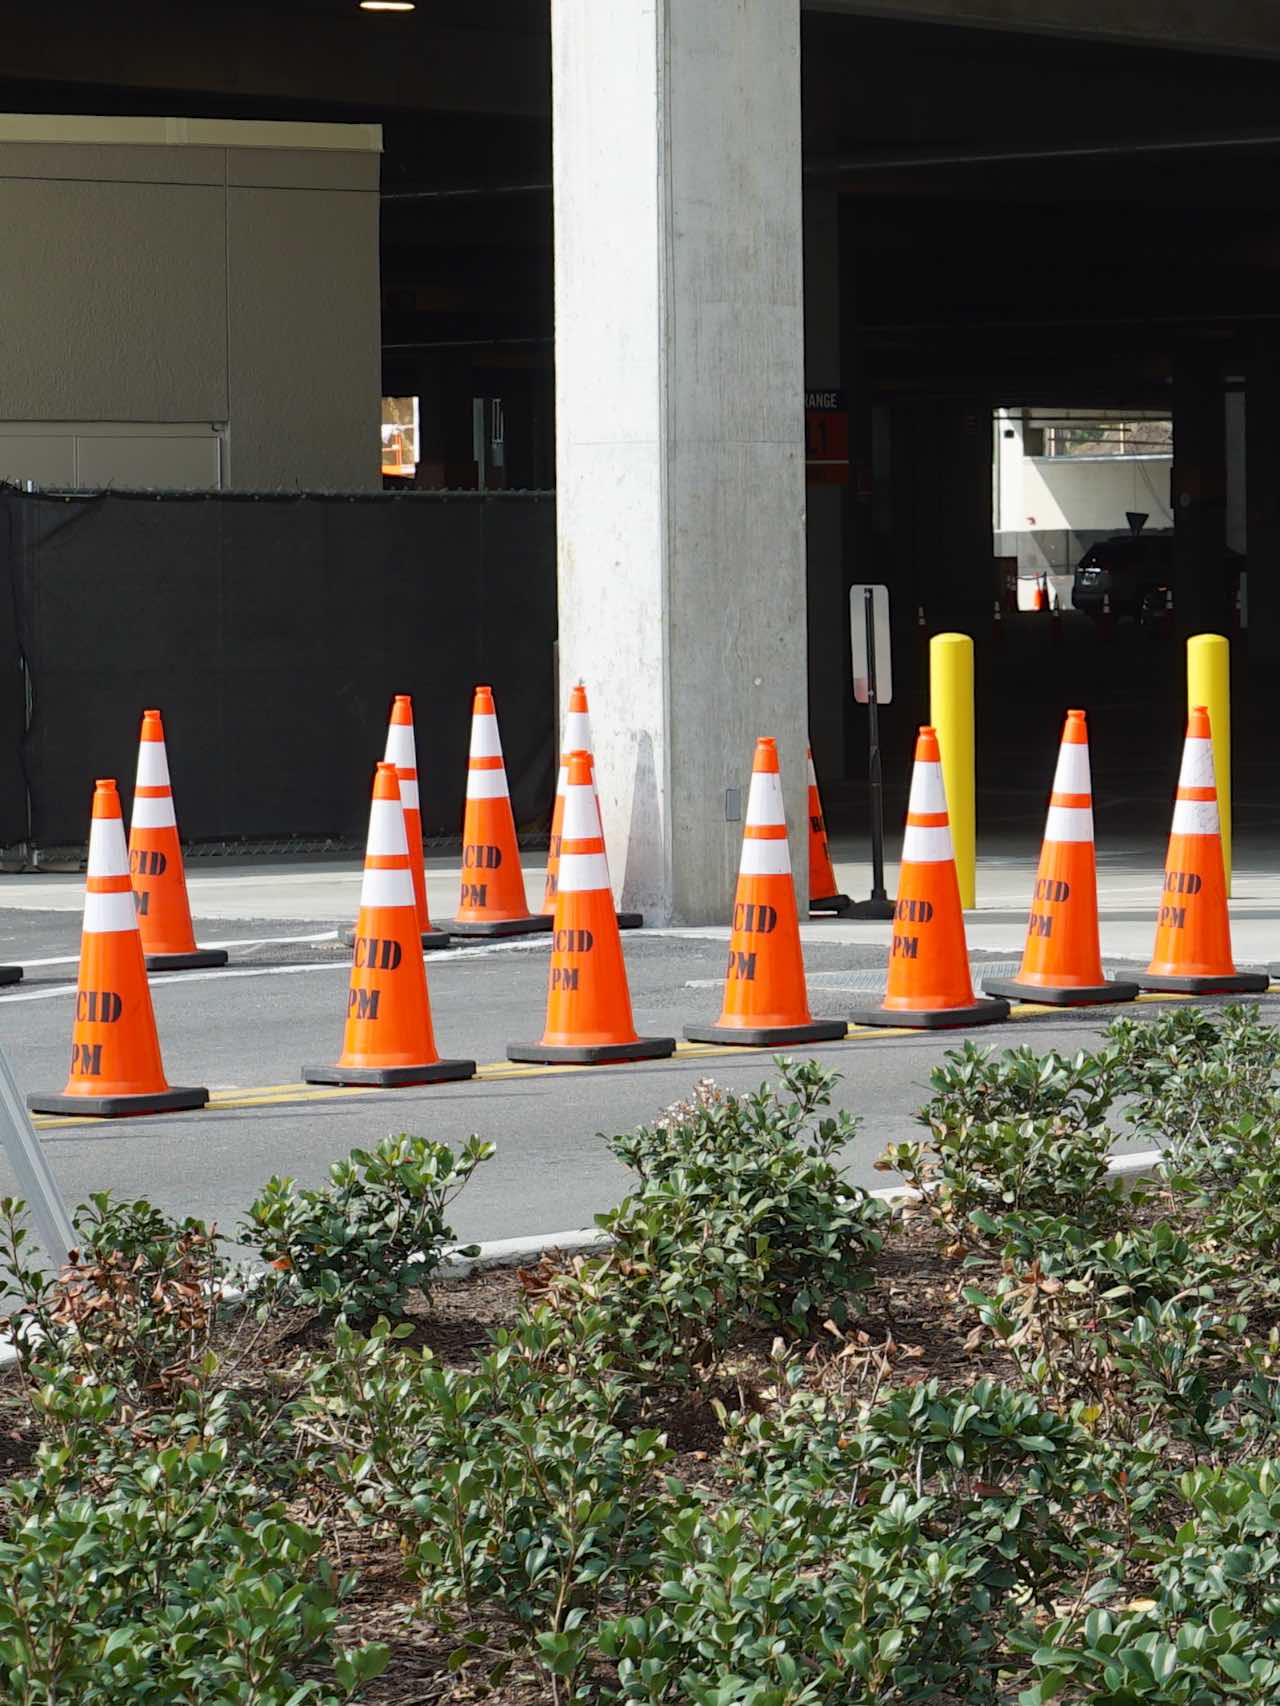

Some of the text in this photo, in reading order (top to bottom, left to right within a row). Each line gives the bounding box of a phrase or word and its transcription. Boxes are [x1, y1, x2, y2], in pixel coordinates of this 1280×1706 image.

[129, 850, 168, 876] CID
[463, 845, 503, 870] CID
[460, 884, 488, 907] PM
[1036, 879, 1070, 902] CID
[1164, 872, 1202, 895] CID
[133, 890, 150, 915] M
[897, 900, 934, 923] CID
[733, 903, 778, 934] CID
[1029, 914, 1053, 938] PM
[1160, 907, 1186, 928] PM
[353, 937, 402, 971] CID
[893, 936, 920, 959] PM
[726, 950, 757, 981] PM
[551, 968, 580, 991] PM
[75, 991, 123, 1023] CID
[346, 988, 381, 1020] PM
[70, 1043, 102, 1076] PM
